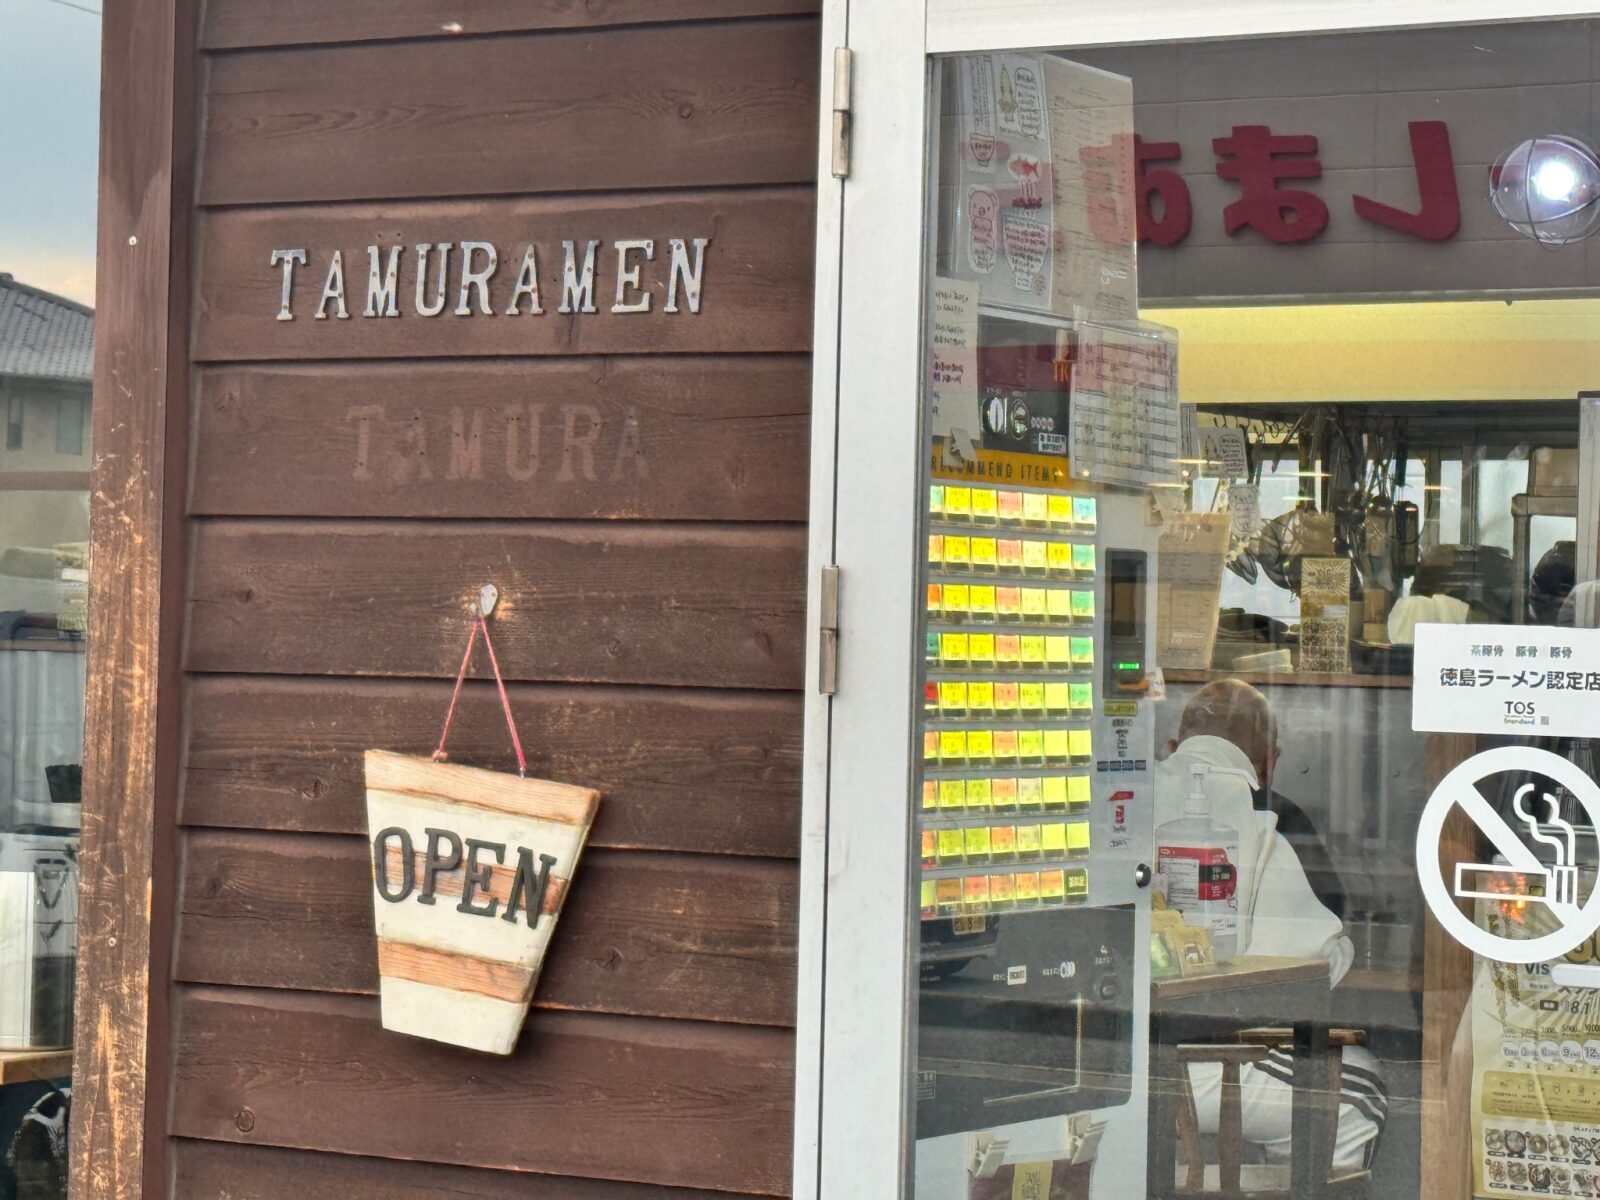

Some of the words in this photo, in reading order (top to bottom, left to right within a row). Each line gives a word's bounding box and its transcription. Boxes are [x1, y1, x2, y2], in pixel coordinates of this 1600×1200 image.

[270, 237, 710, 322] TAMURAMEN
[346, 402, 651, 482] TAMURA
[1440, 667, 1600, 691] 徳島ラーメン認定店
[1504, 701, 1536, 715] TOS
[372, 826, 557, 930] OPEN
[1525, 963, 1551, 976] VIS
